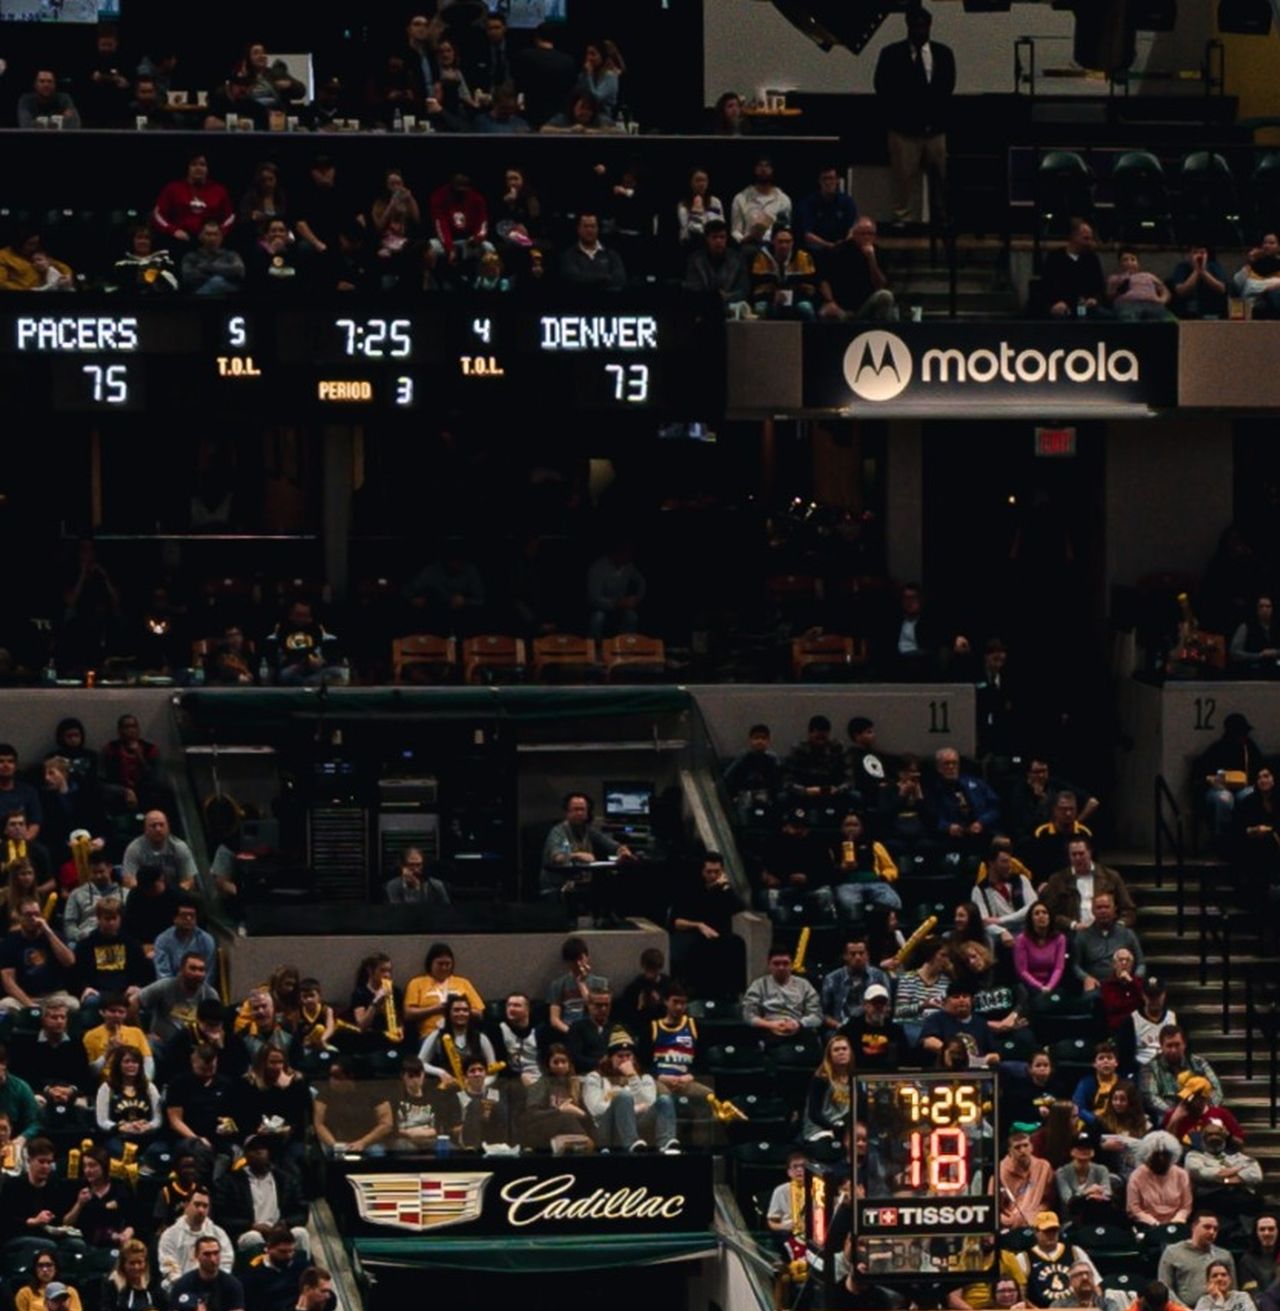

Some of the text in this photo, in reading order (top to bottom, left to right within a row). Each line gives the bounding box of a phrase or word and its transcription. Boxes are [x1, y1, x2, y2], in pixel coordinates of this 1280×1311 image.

[17, 317, 138, 350] PACERS
[335, 320, 411, 357] 7:25
[473, 318, 490, 343] 4
[540, 317, 656, 349] DENVER
[217, 357, 260, 376] T.O.L.
[461, 356, 503, 375] T.O.L.
[921, 341, 1139, 383] motorola
[84, 366, 126, 401] 75
[318, 381, 371, 400] PERIOD
[396, 377, 413, 404] 3
[605, 365, 648, 402] 73
[928, 702, 950, 733] 11
[1193, 698, 1216, 731] 12
[900, 1086, 977, 1123] 7:25
[911, 1128, 967, 1190] 18
[501, 1174, 685, 1226] Cadillac
[899, 1206, 990, 1225] TISSOT
